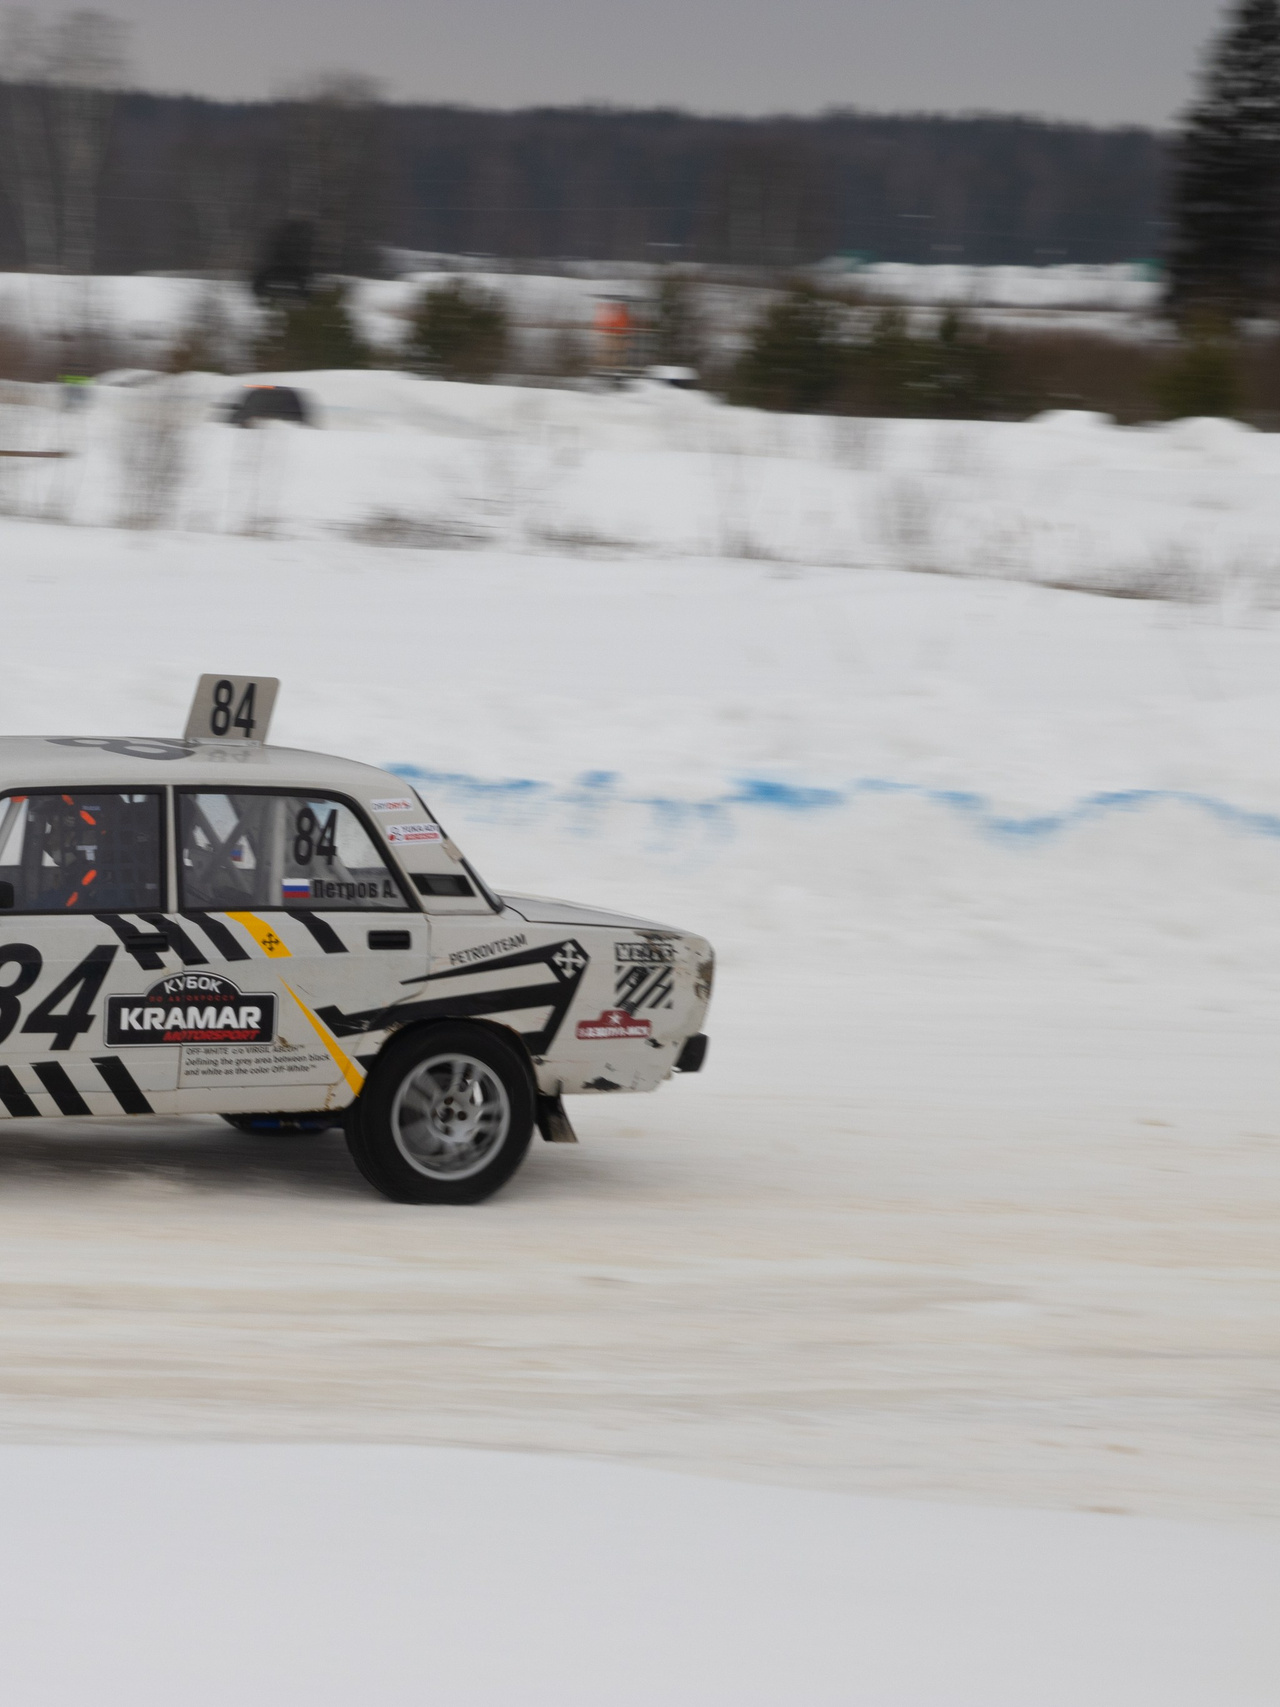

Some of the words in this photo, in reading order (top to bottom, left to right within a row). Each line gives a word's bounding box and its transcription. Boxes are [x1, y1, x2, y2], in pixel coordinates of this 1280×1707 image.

[210, 679, 257, 738] 84
[293, 807, 339, 865] 84
[313, 879, 378, 900] Петров
[163, 976, 223, 994] КУБОК
[120, 1006, 262, 1031] KRAMAR
[163, 1030, 261, 1042] MOTORSPORT
[185, 1057, 219, 1067] Defining
[221, 1057, 233, 1065] the
[273, 1054, 307, 1064] between
[309, 1054, 331, 1062] black
[184, 1067, 200, 1076] and
[201, 1067, 222, 1076] white
[235, 1067, 248, 1075] the
